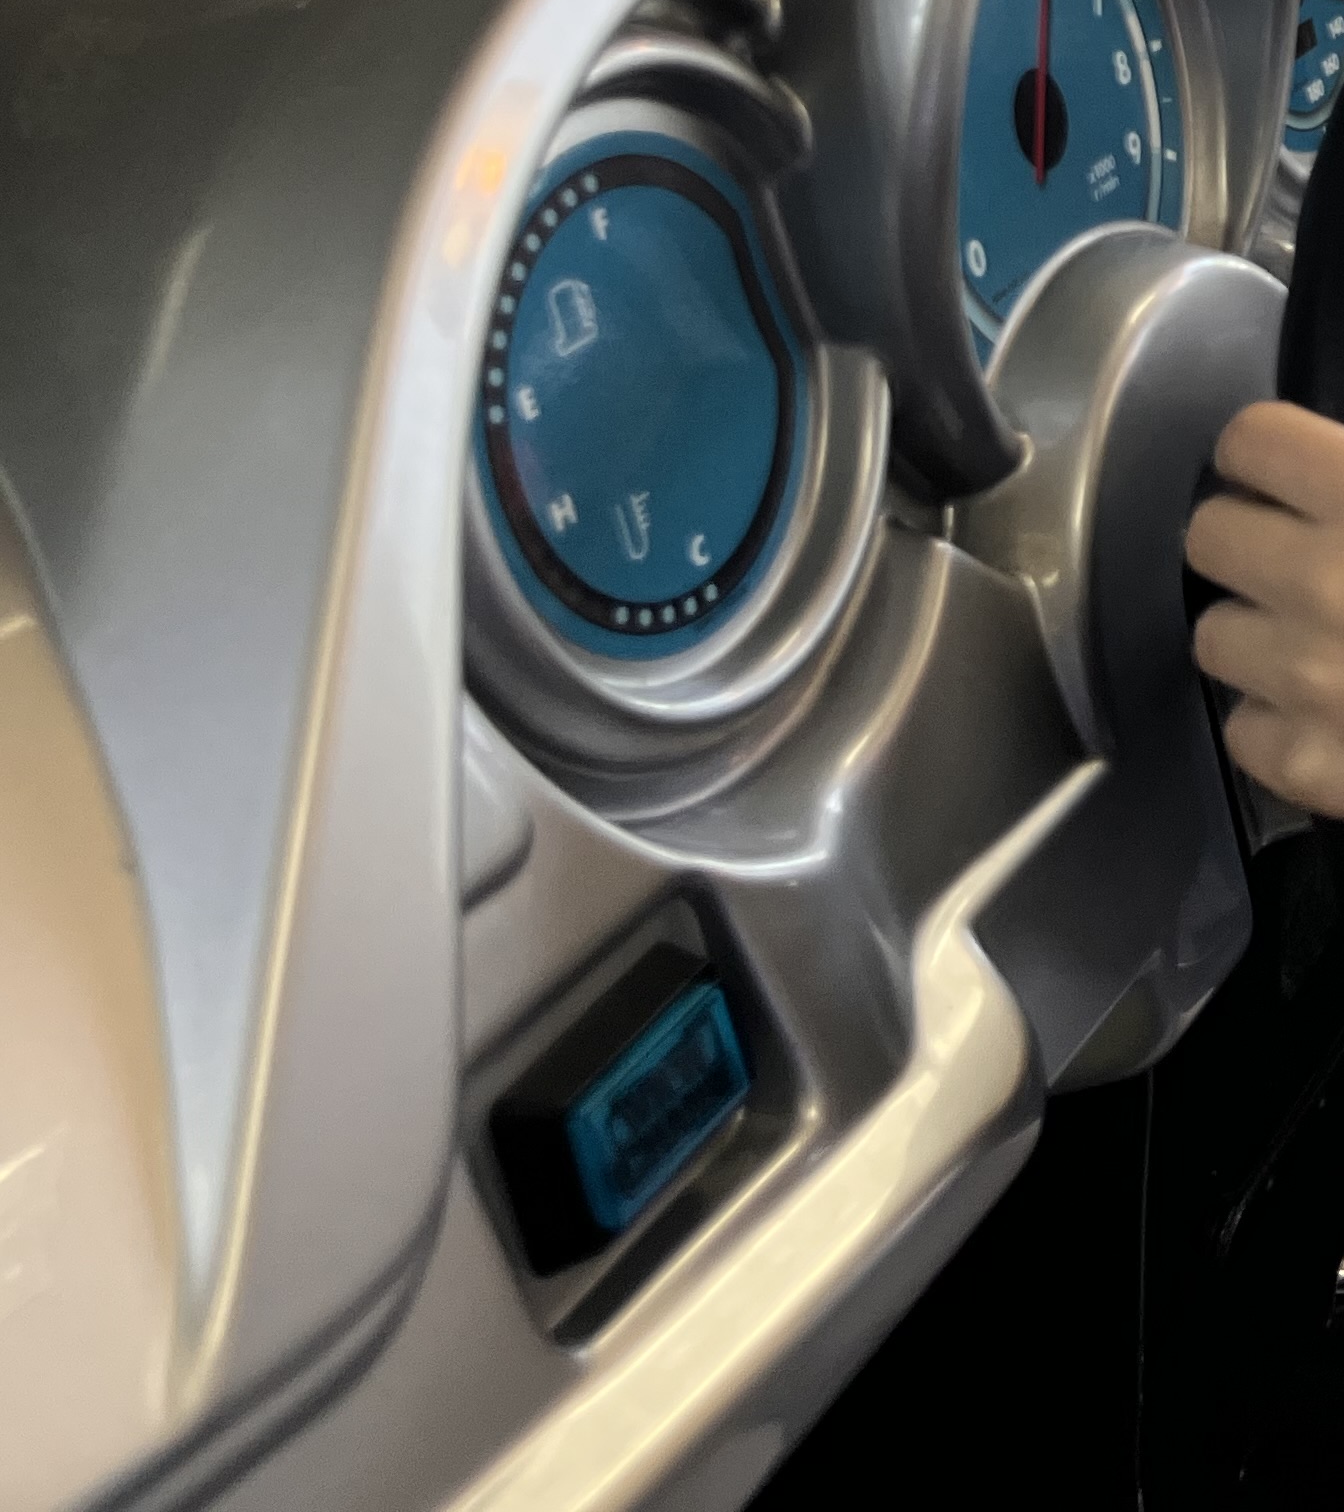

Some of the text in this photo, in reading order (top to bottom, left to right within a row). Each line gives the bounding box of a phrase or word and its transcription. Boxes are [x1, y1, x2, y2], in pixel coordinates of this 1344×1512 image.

[1113, 50, 1131, 85] 8
[1125, 131, 1141, 165] 9
[593, 207, 609, 240] F
[966, 239, 987, 278] 0
[516, 386, 540, 421] E
[549, 492, 578, 532] H
[690, 534, 711, 566] C
